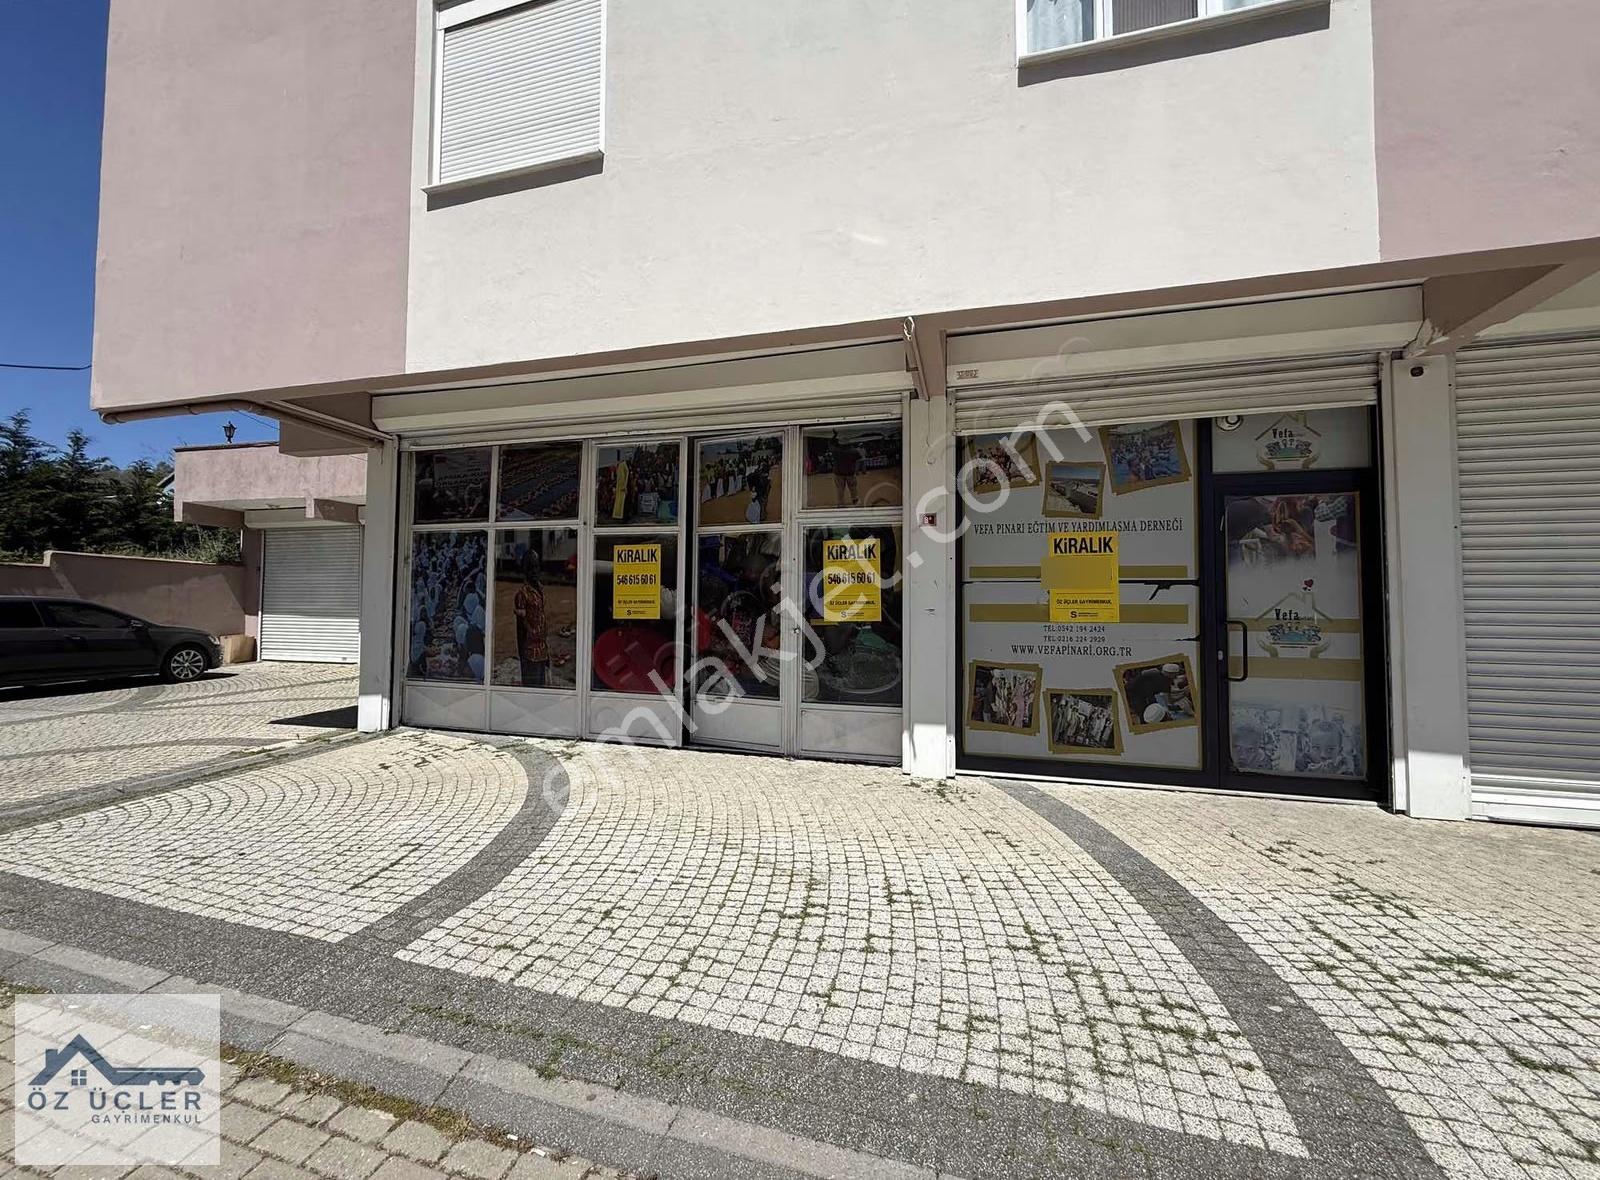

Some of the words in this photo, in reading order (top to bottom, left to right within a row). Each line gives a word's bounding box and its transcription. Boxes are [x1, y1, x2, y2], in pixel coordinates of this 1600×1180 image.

[1272, 428, 1294, 439] Vefa
[974, 523, 994, 535] VEFA
[1058, 521, 1069, 533] VE
[1140, 517, 1183, 532] DERNEĞİ
[617, 574, 628, 585] 546
[628, 574, 640, 585] 615
[640, 573, 648, 585] 60
[649, 573, 656, 585] 61
[828, 573, 841, 585] 546
[842, 572, 856, 585] 615
[856, 571, 866, 584] 60
[866, 571, 876, 584] 61
[1274, 608, 1299, 621] Vefa
